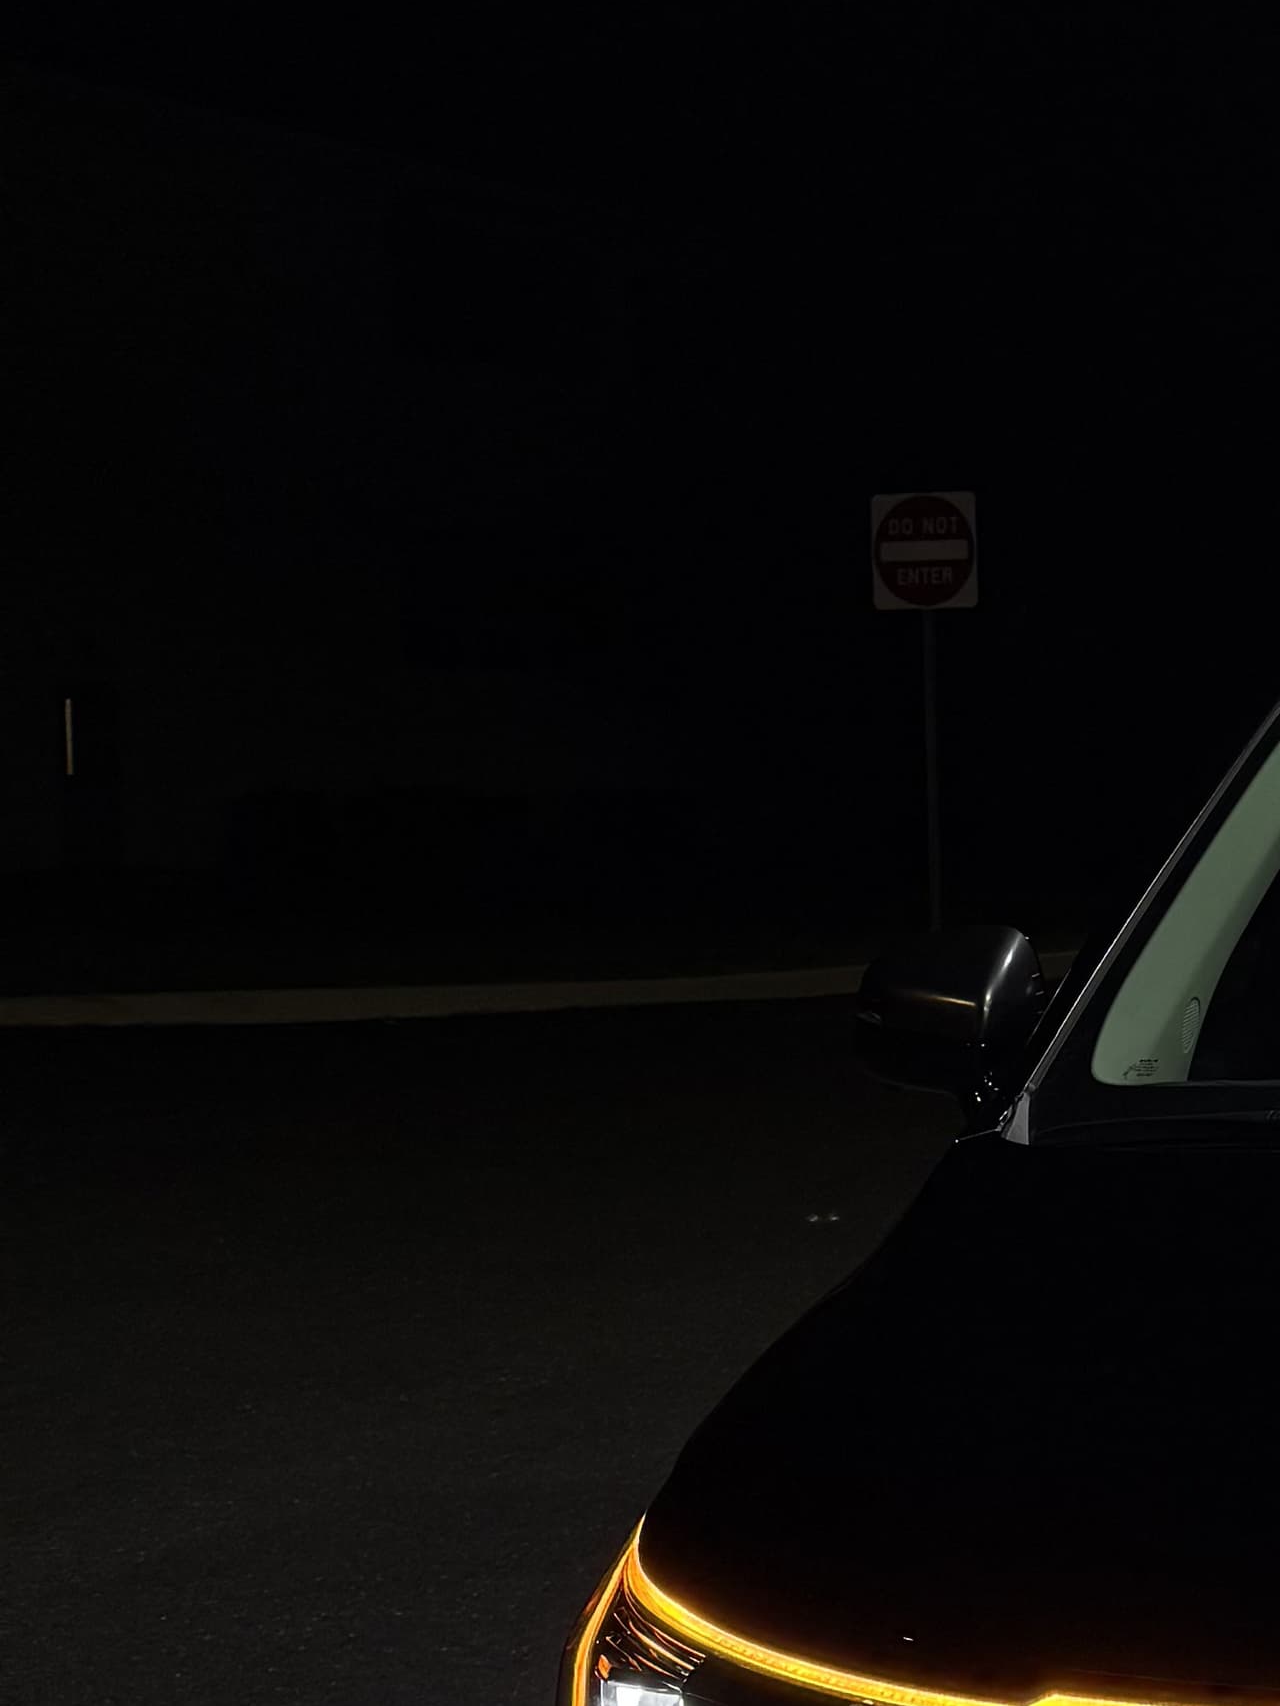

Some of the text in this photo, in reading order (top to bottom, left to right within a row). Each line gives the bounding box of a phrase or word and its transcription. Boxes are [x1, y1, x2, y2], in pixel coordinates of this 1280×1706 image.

[887, 516, 958, 536] DO NOT
[896, 566, 954, 586] ENTER
